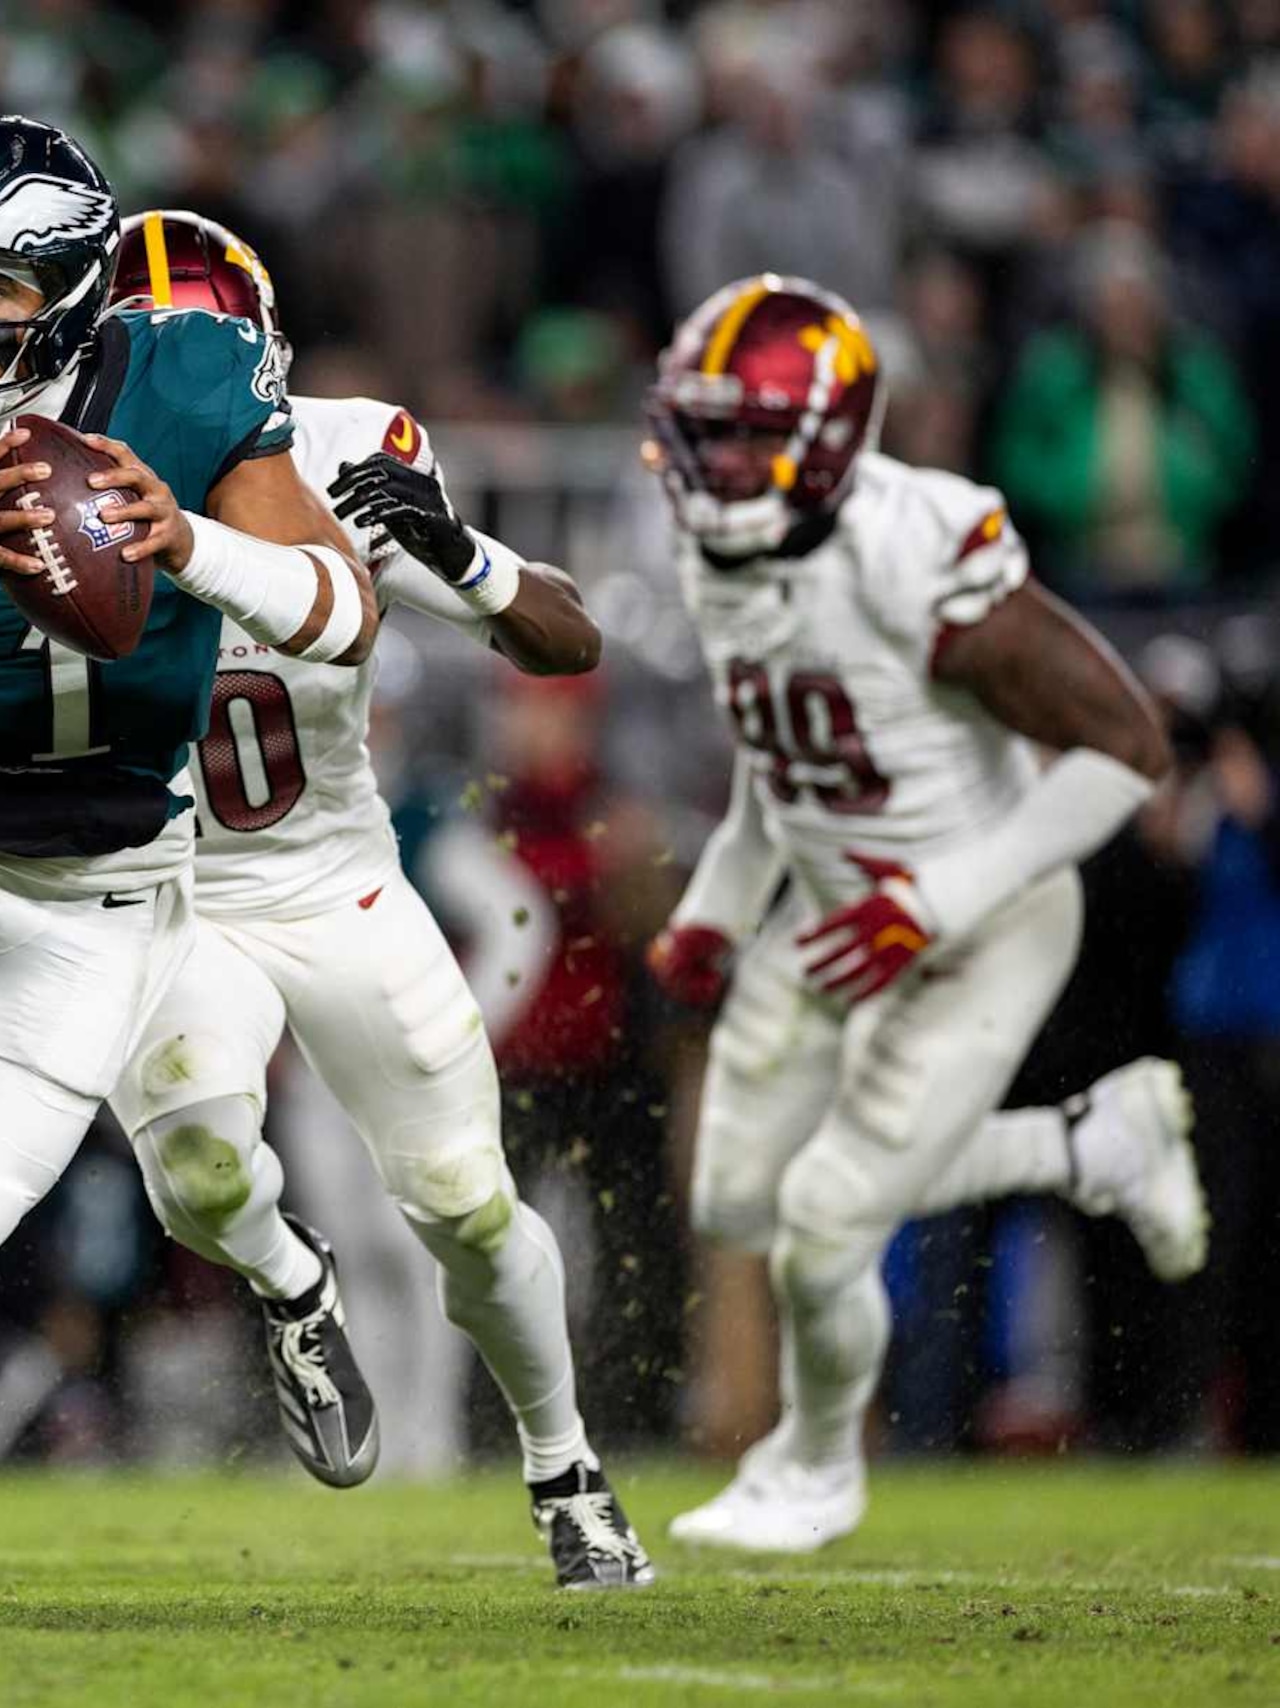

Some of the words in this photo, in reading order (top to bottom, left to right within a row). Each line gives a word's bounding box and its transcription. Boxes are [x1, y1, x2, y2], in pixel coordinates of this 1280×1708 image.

[21, 625, 112, 763] 1
[194, 669, 308, 837] 0
[727, 656, 894, 817] 99
